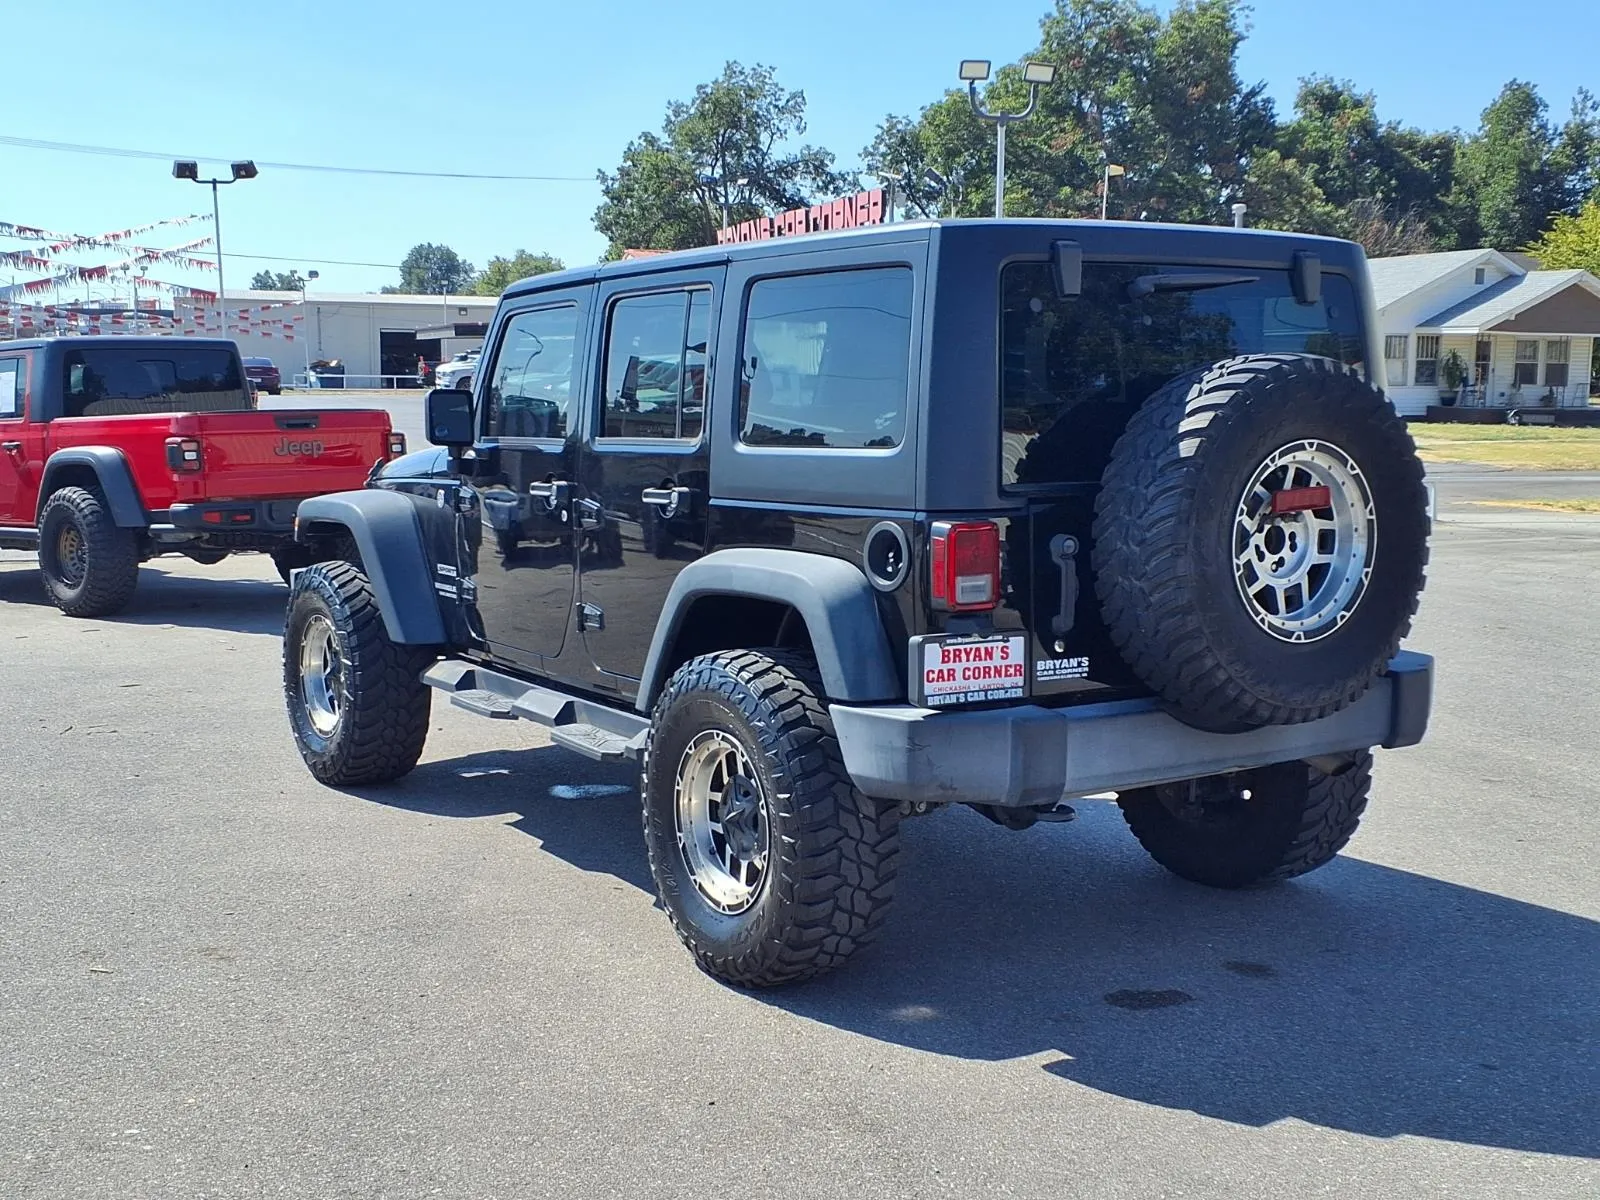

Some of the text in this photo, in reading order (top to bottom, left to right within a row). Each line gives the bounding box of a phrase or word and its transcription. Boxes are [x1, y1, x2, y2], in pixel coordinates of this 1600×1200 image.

[274, 437, 324, 458] Jeep
[941, 645, 1010, 664] BRYAN'S
[1037, 657, 1089, 670] BRYAN'S
[926, 668, 957, 683] CAR
[962, 664, 1023, 680] CORNER
[927, 692, 966, 706] BRYAN'S
[967, 691, 986, 702] CAR
